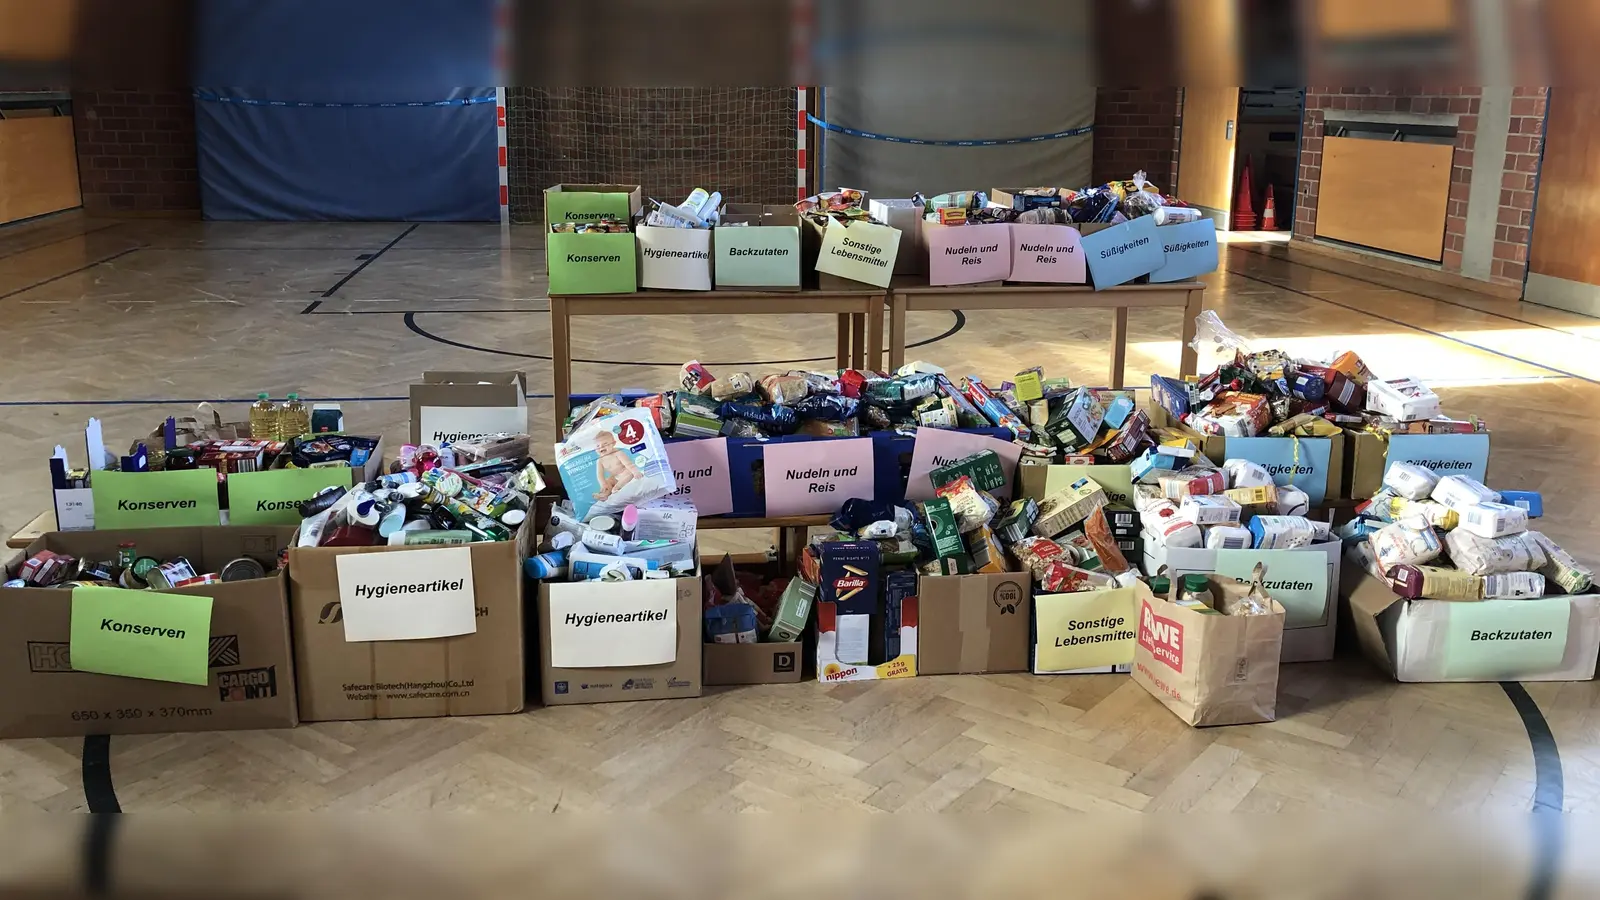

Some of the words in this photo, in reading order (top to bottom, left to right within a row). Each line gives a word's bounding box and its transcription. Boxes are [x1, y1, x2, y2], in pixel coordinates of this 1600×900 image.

[565, 211, 616, 220] Konserven
[728, 246, 789, 257] Backzutaten
[841, 237, 882, 255] Sonstige
[945, 245, 977, 256] Nudeln
[980, 244, 998, 254] und
[1020, 243, 1053, 254] Nudeln
[1056, 244, 1074, 254] und
[1100, 235, 1149, 260] Süßigkeiten
[1163, 238, 1209, 253] Süßigkeiten
[566, 253, 621, 263] Konserven
[643, 247, 711, 260] Hygieneartikel
[830, 246, 888, 268] Lebensmittel
[1036, 254, 1057, 264] Reis
[961, 255, 982, 266] Reis
[625, 424, 637, 439] 4
[688, 465, 713, 478] und
[786, 468, 830, 480] Nudeln
[833, 466, 858, 477] und
[808, 482, 836, 493] Reis
[117, 499, 197, 511] Konserven
[355, 579, 463, 599] Hygieneartikel
[837, 579, 864, 588] Barilla
[564, 609, 668, 627] Hygieneartikel
[1068, 616, 1125, 631] Sonstige
[100, 618, 186, 640] Konserven
[1470, 630, 1552, 641] Backzutaten
[778, 655, 791, 667] D
[219, 670, 269, 687] CARGO
[826, 667, 858, 681] nippon
[886, 667, 909, 677] GRATIS
[342, 683, 375, 692] Safecare
[71, 710, 99, 721] 650
[103, 711, 112, 720] x
[116, 707, 143, 719] 350
[147, 709, 155, 718] x
[159, 706, 213, 718] 370mm
